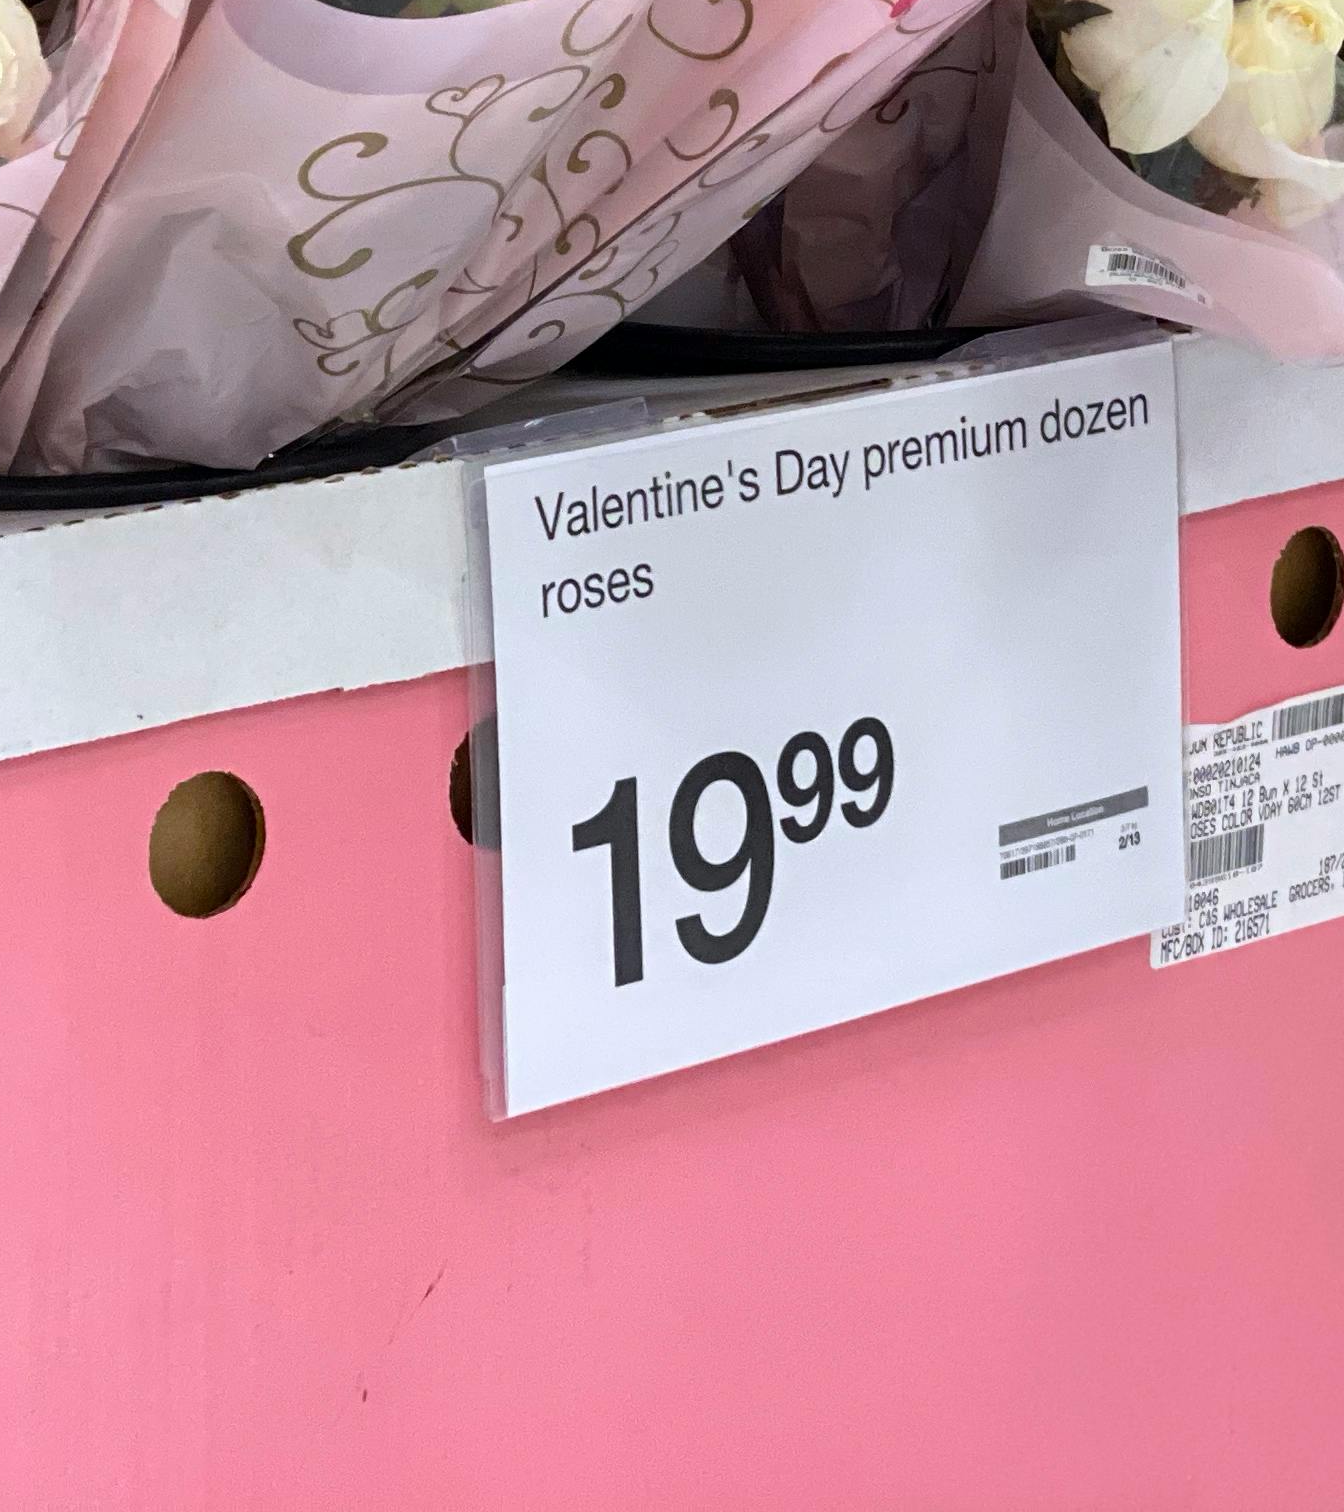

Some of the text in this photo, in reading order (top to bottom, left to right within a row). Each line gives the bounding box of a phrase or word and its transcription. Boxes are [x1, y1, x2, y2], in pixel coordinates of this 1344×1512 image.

[535, 392, 1150, 541] Valentine's Day premium dozen
[541, 562, 655, 618] roses
[1213, 721, 1263, 749] REPUBLIC
[1242, 789, 1254, 808] 12
[1283, 779, 1290, 797] X
[1295, 774, 1307, 793] 12
[1221, 807, 1253, 831] COLOR
[1119, 831, 1141, 850] 2/13
[1223, 890, 1278, 922] WHOLESALE
[1235, 913, 1270, 944] 216571
